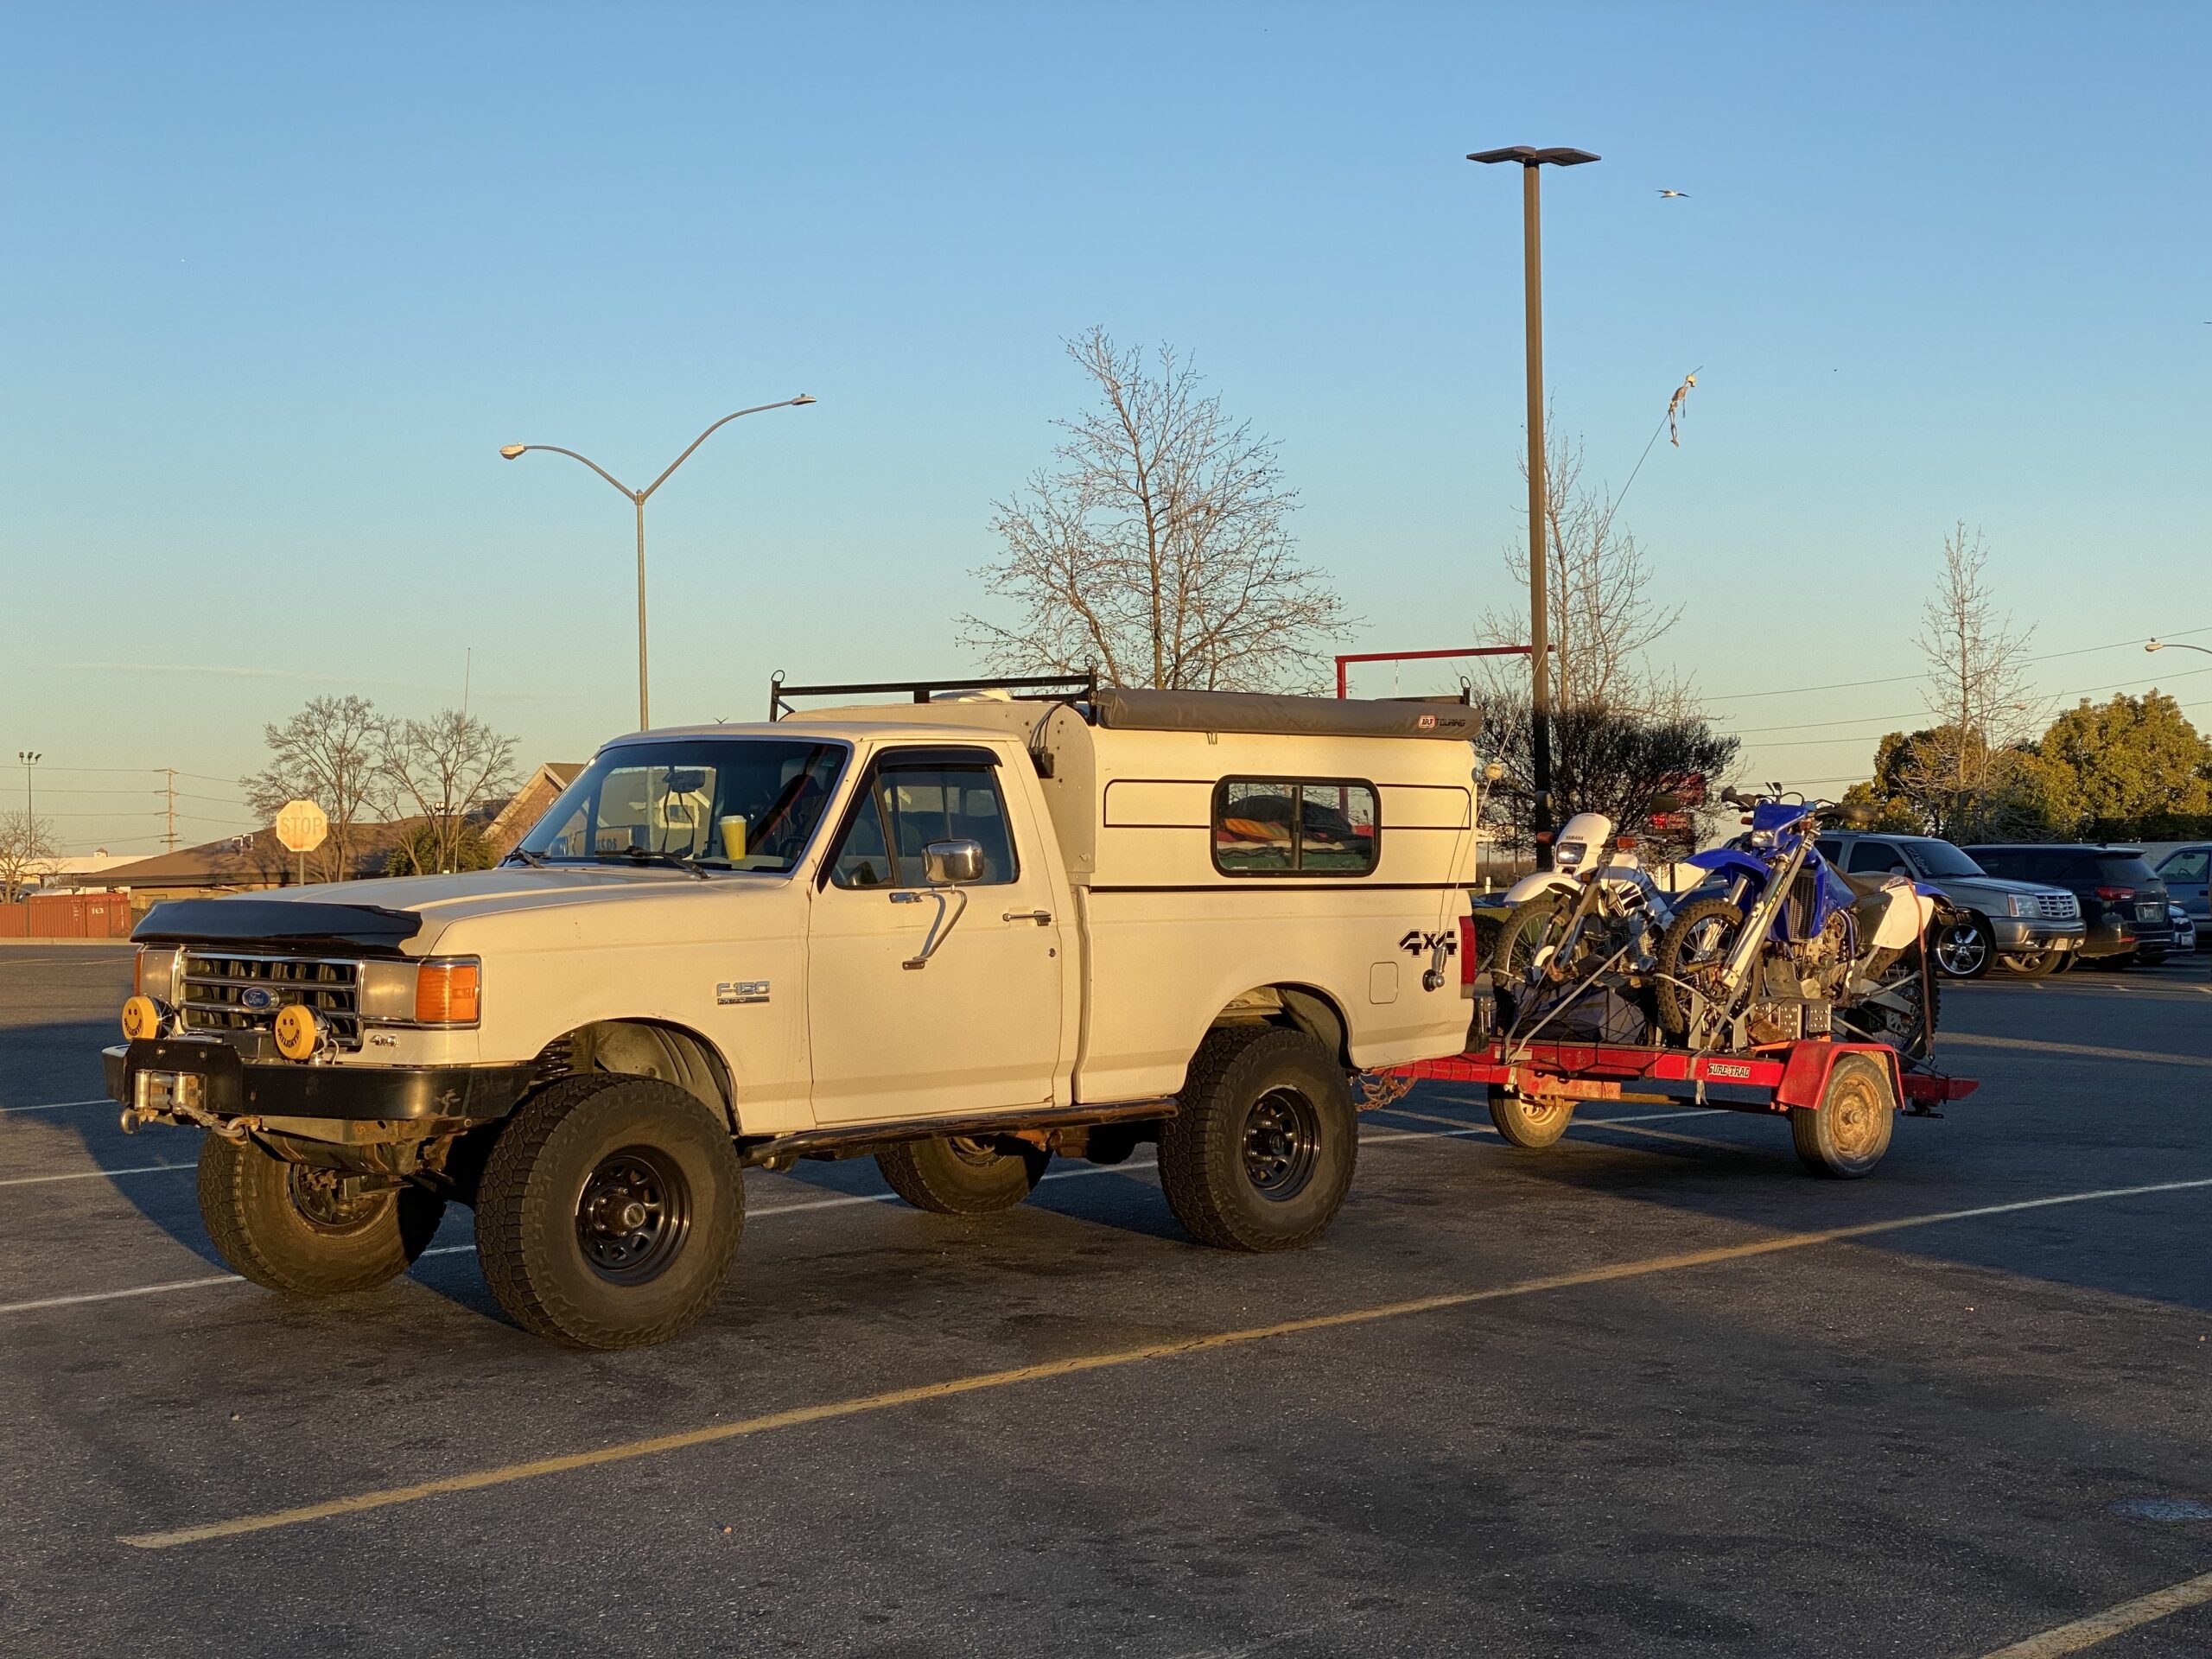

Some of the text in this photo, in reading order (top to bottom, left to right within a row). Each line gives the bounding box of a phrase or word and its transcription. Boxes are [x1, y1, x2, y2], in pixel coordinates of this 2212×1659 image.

[1435, 718, 1466, 727] TOURING
[281, 817, 323, 836] STOP
[716, 981, 770, 996] F-150
[248, 991, 264, 1004] Ford
[1708, 1064, 1750, 1077] SURE-TRAC
